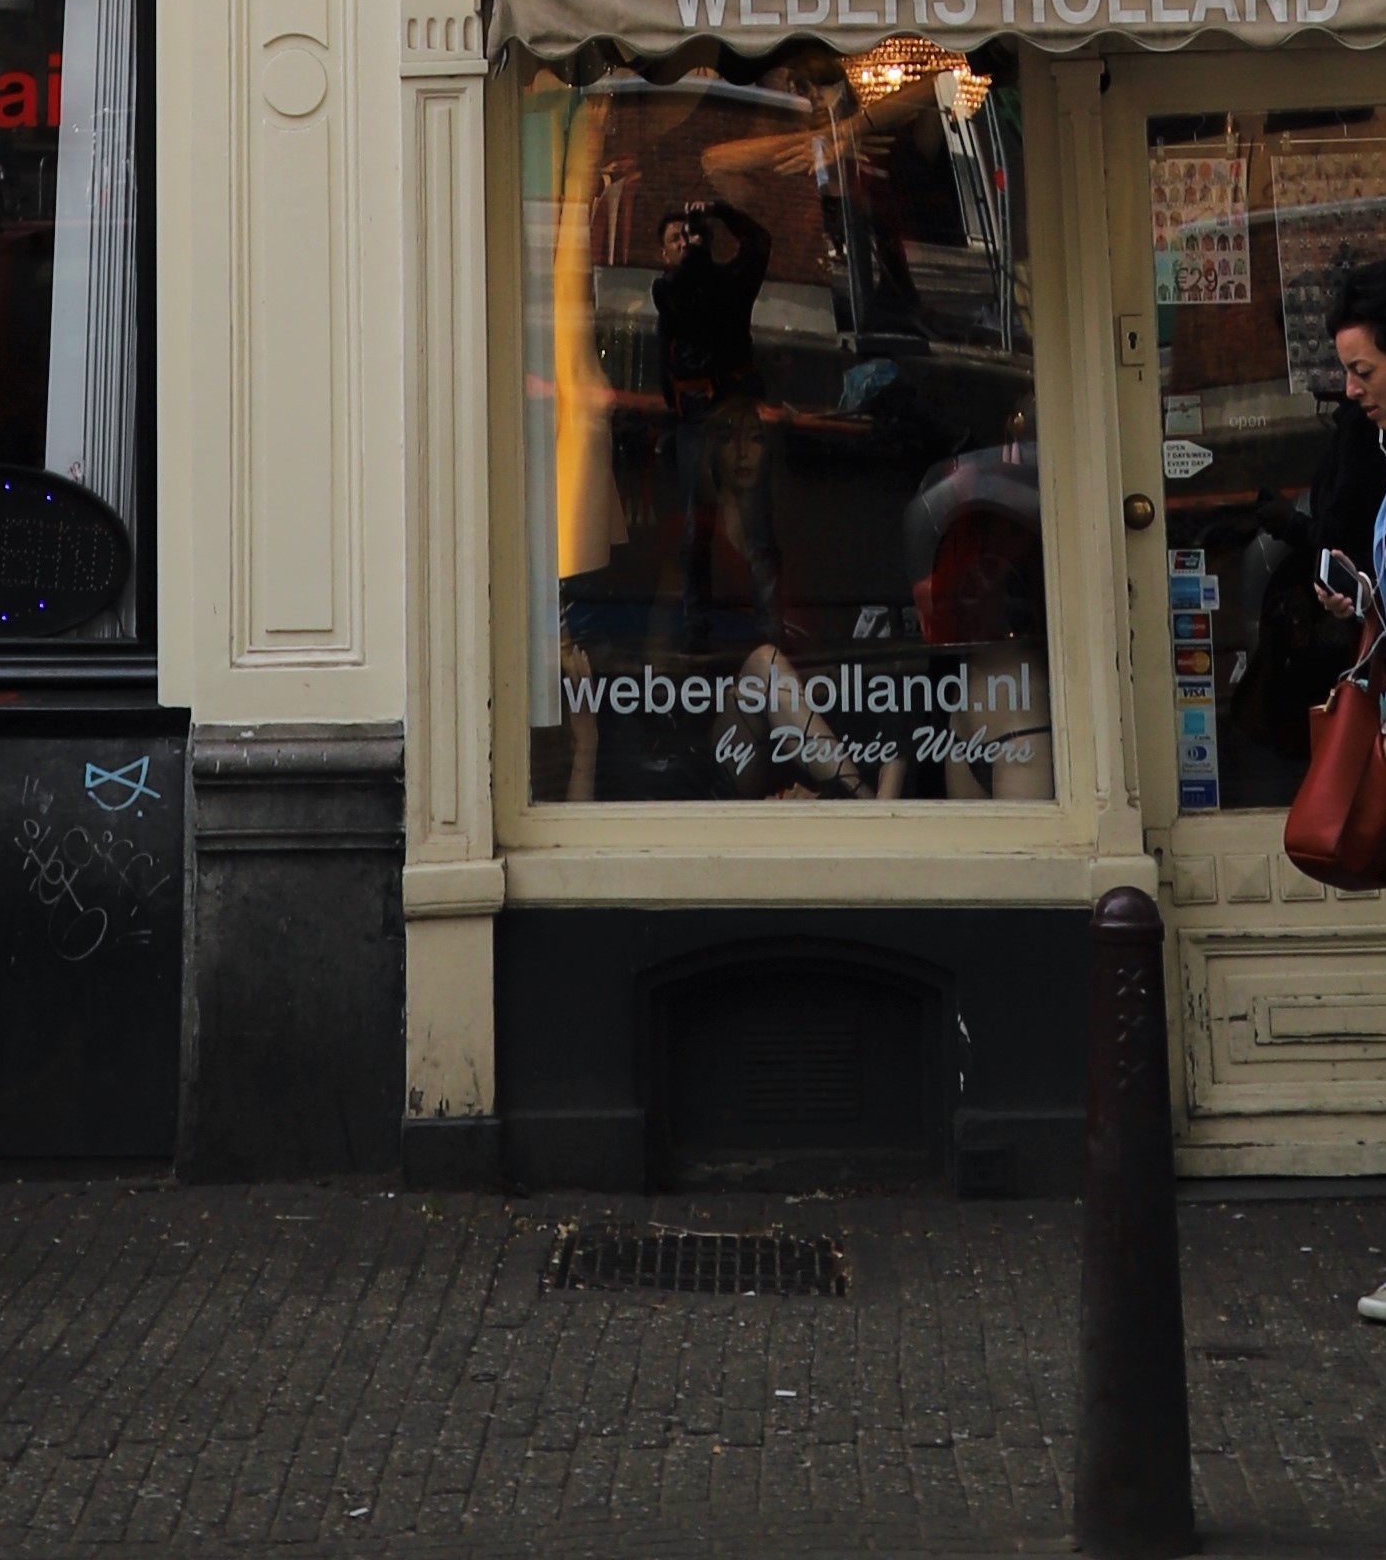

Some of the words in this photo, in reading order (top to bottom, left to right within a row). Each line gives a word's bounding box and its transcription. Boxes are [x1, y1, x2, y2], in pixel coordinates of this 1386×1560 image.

[563, 663, 1031, 715] webersholland.nl
[1182, 687, 1207, 698] VISA
[715, 724, 755, 775] by
[770, 724, 899, 765] Désirée
[911, 724, 1033, 764] Webers
